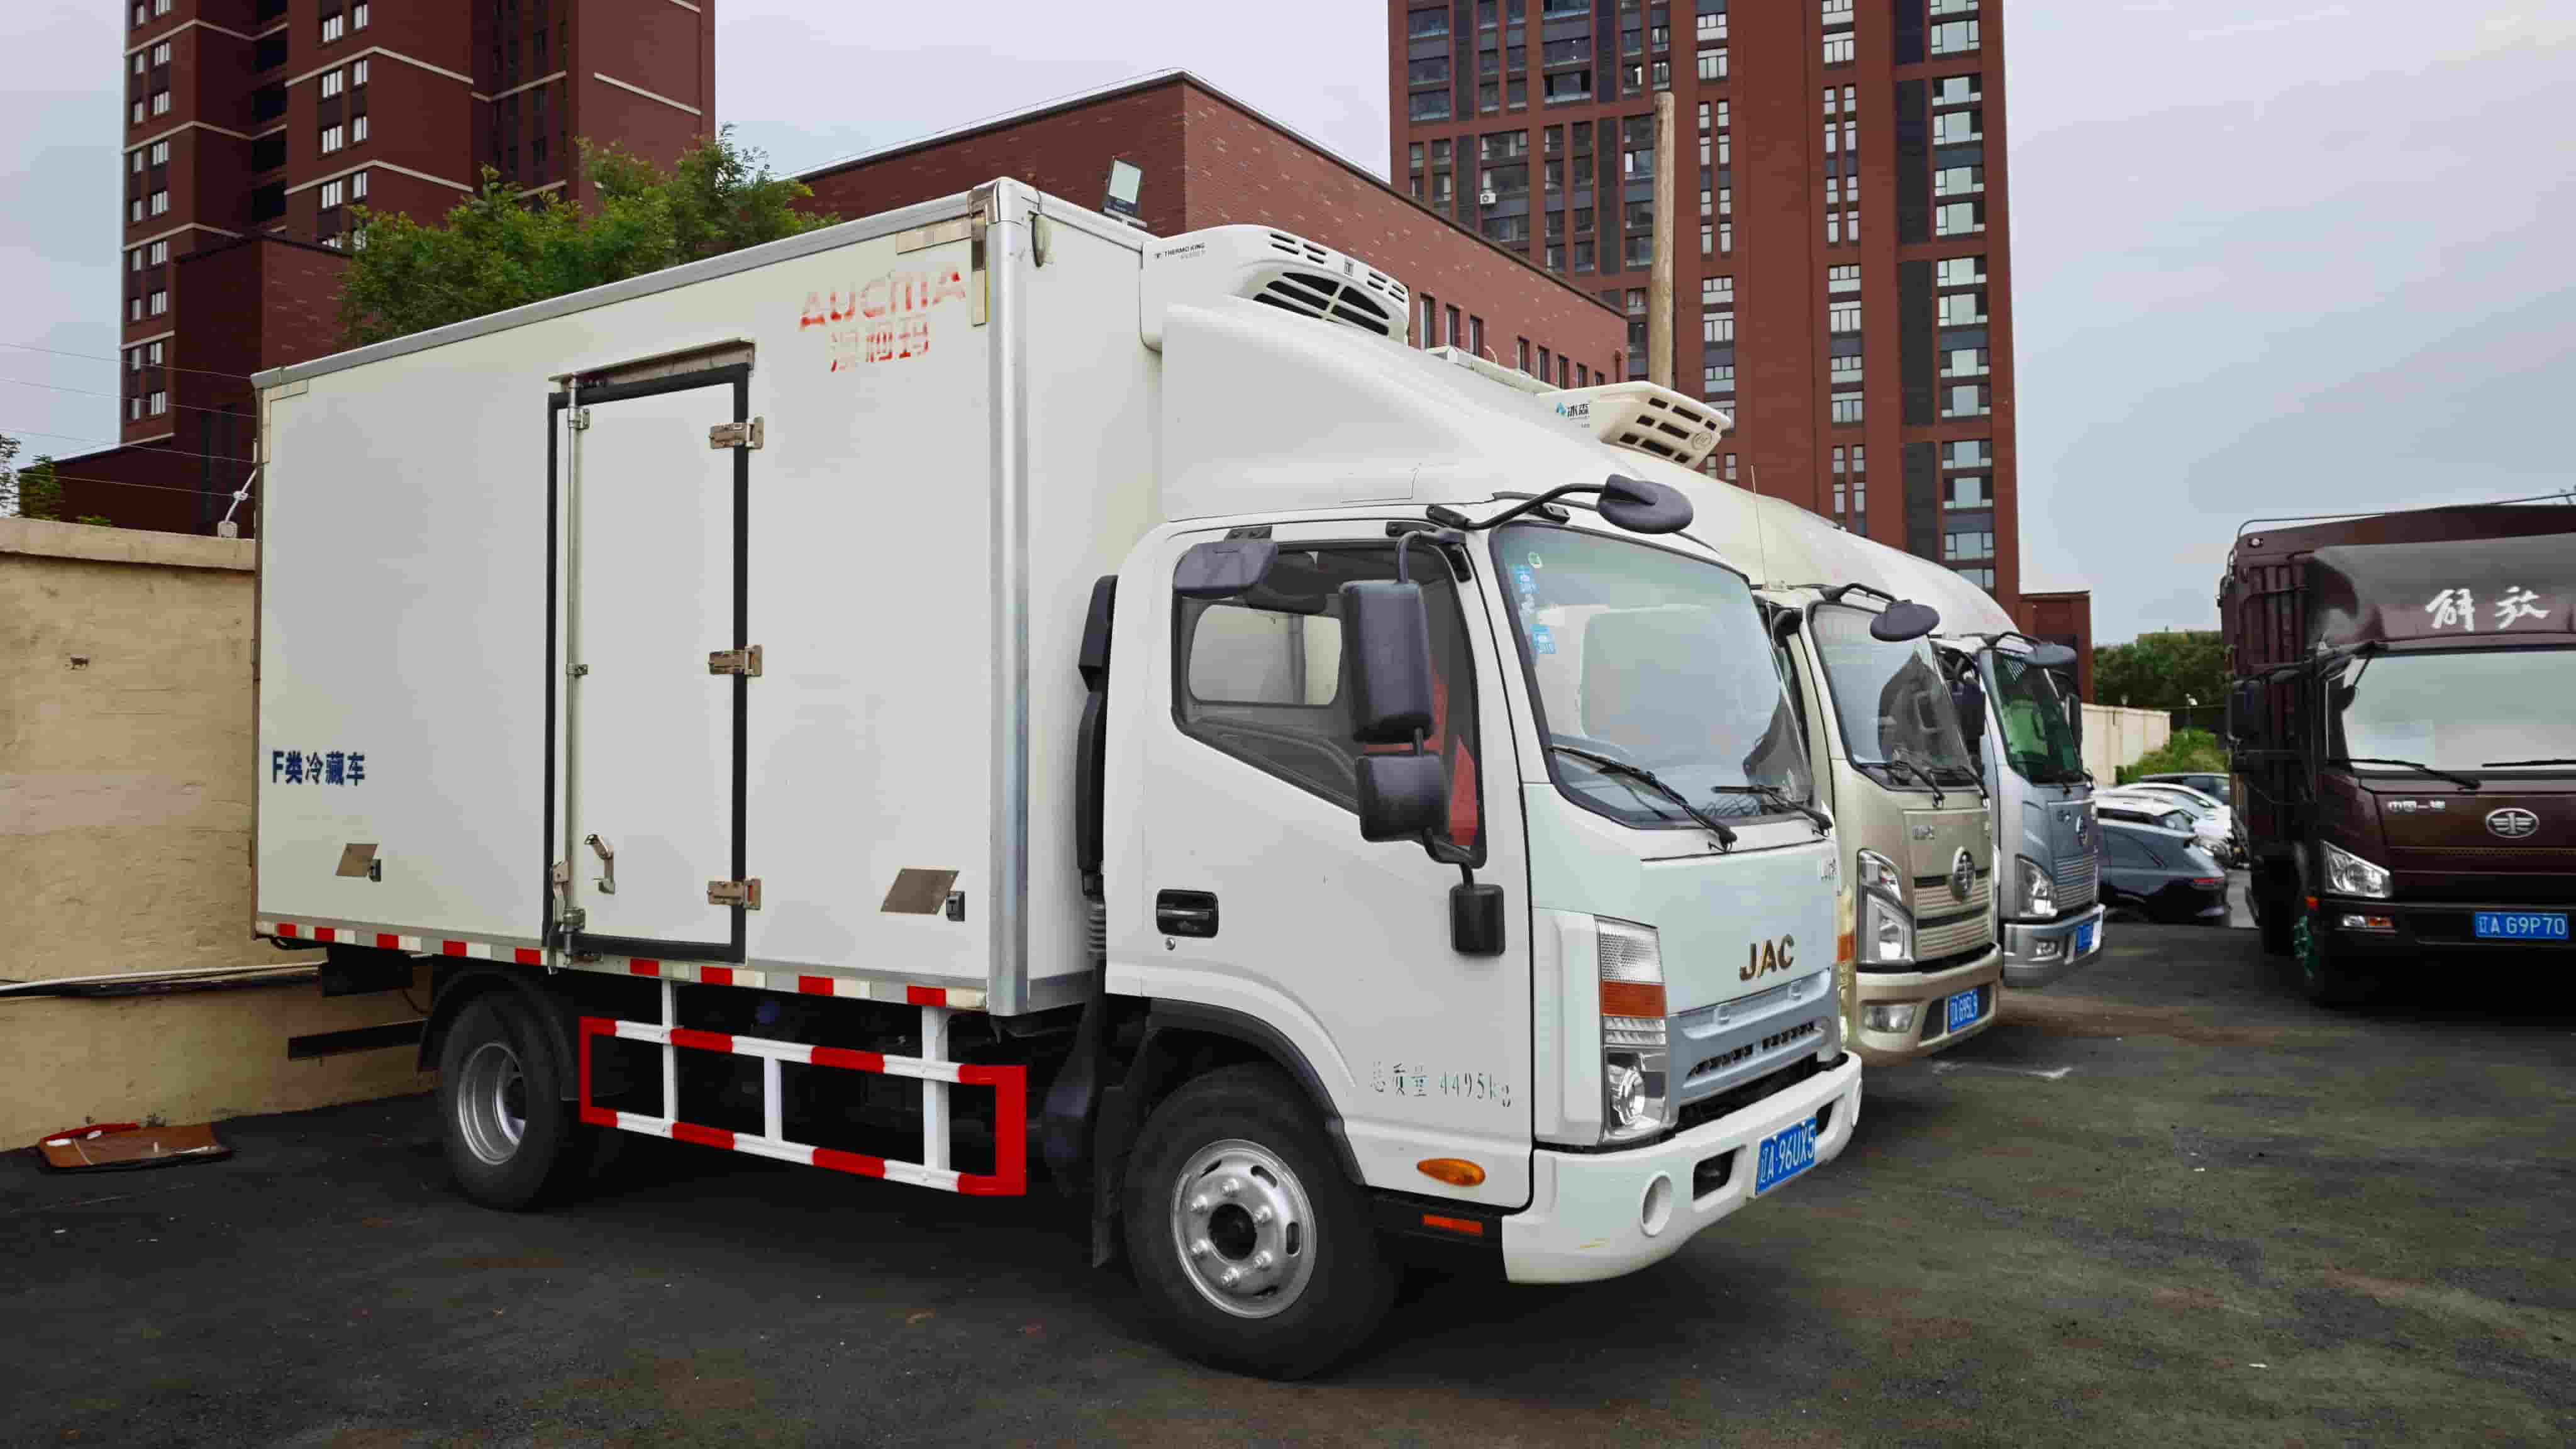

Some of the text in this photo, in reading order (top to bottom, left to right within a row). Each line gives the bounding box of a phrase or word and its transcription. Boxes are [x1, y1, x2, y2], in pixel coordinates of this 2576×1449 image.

[2425, 589, 2551, 631] 解放
[272, 750, 365, 787] F类冷藏车
[1740, 935, 1794, 981] JAC
